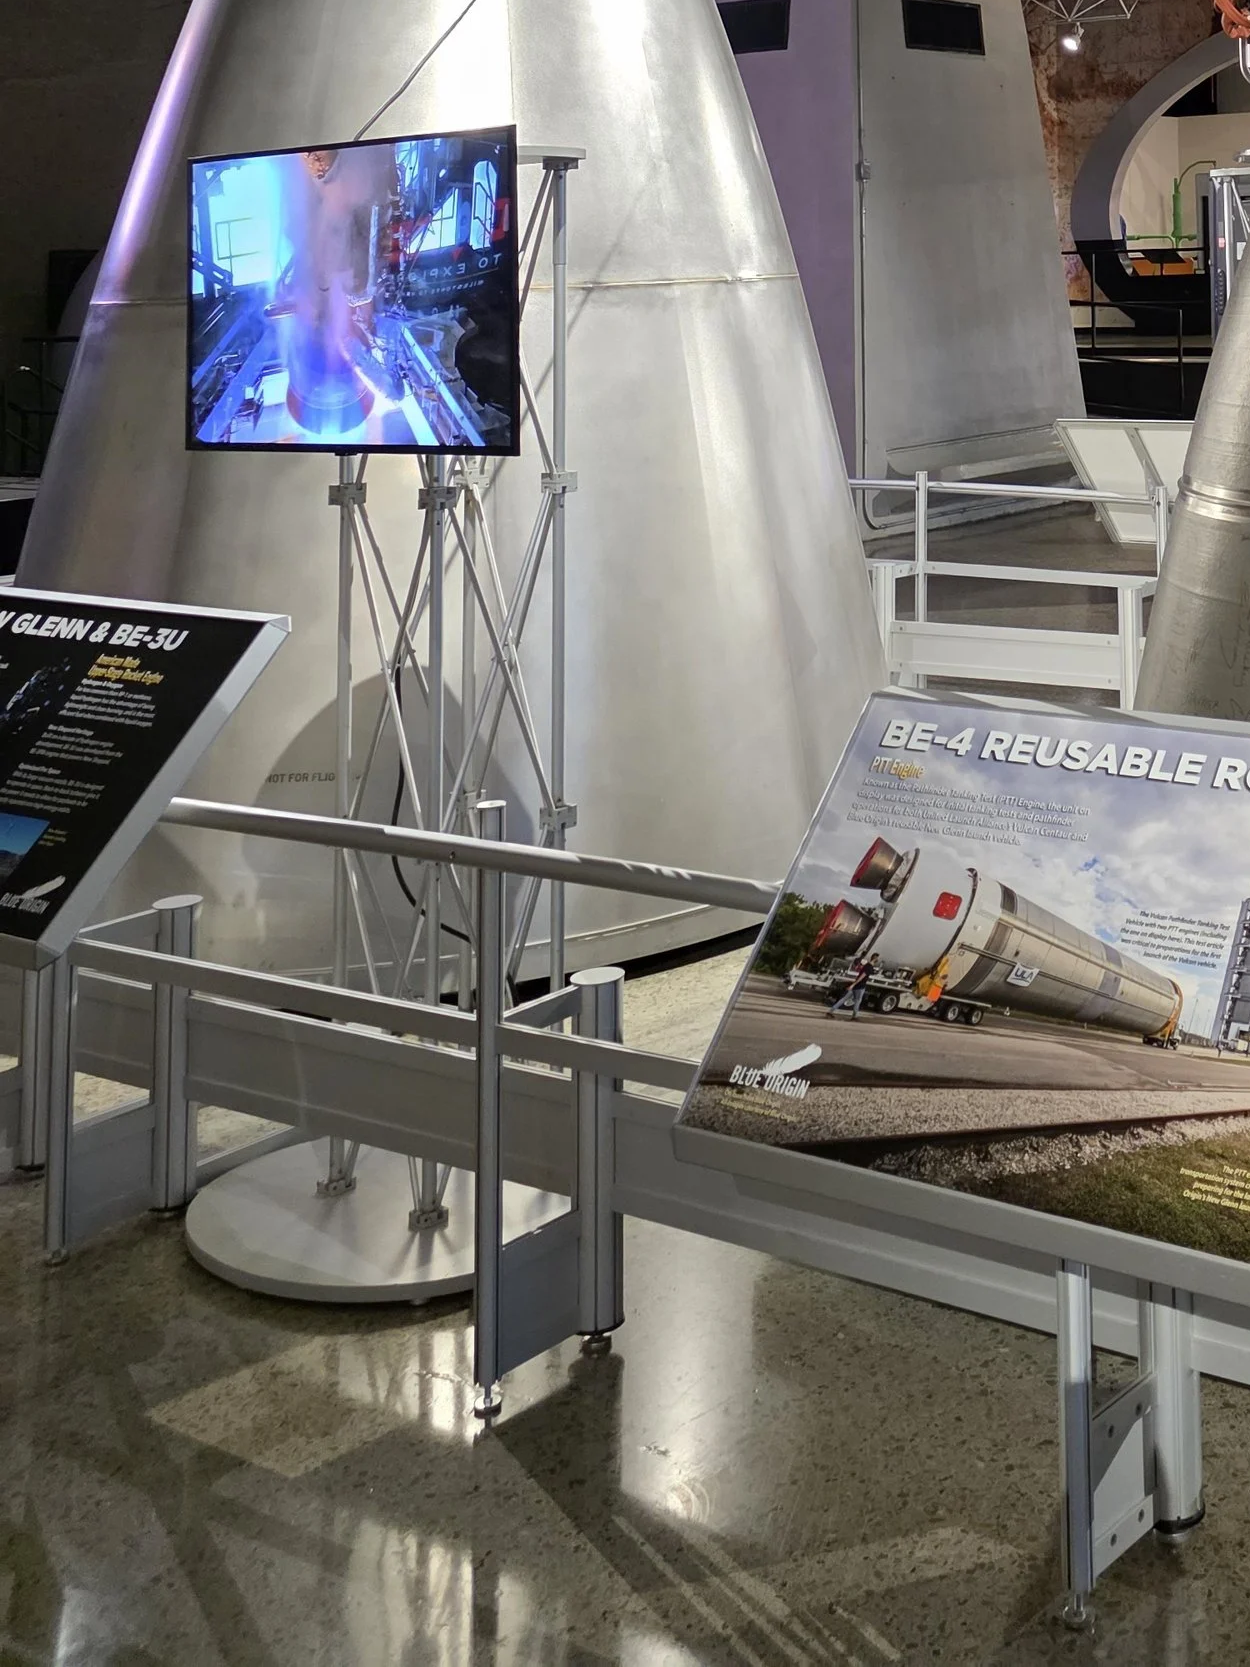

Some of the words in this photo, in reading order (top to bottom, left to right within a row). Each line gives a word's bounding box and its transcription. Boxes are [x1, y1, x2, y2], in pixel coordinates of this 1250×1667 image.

[11, 612, 94, 641] GLENN
[89, 621, 112, 643] &
[108, 623, 189, 651] BE-3U
[880, 719, 976, 757] BE-4
[980, 730, 1207, 785] REUSABLE
[264, 773, 287, 784] NOT
[288, 772, 309, 783] FOR
[311, 772, 336, 783] FLIG
[869, 756, 892, 774] PTT
[890, 758, 926, 780] Engine
[863, 777, 889, 789] Known
[898, 782, 912, 792] the
[912, 783, 948, 797] Pathfinder
[950, 789, 978, 803] Tanking
[980, 793, 995, 804] Test
[1047, 801, 1061, 813] the
[1061, 803, 1080, 815] unit
[1080, 807, 1091, 817] on
[857, 789, 883, 801] display
[884, 793, 900, 803] was
[900, 795, 933, 808] designed
[944, 800, 967, 813] initial
[968, 803, 998, 818] tanking
[999, 807, 1017, 819] tests
[1017, 811, 1032, 822] and
[1032, 813, 1074, 827] pathfinder
[852, 802, 891, 815] operations
[903, 806, 921, 818] both
[921, 809, 948, 822] United
[948, 813, 976, 827] Launch
[1012, 822, 1040, 835] Vulcan
[1040, 826, 1071, 840] Centaur
[1071, 831, 1089, 842] and
[942, 825, 965, 838] Glenn
[965, 828, 992, 842] launch
[1125, 918, 1144, 928] Vehicle
[1144, 921, 1157, 929] with
[1156, 923, 1167, 931] two
[1167, 924, 1179, 932] PTT
[1178, 927, 1199, 937] engines
[1140, 910, 1149, 918] The
[1150, 912, 1168, 922] Vulcan
[1168, 914, 1197, 925] Pathfinder
[1197, 919, 1219, 931] Tanking
[1219, 922, 1230, 931] Test
[1015, 967, 1034, 981] ULA
[729, 1064, 762, 1089] BLUE
[763, 1073, 811, 1099] ORIGIN
[1179, 1167, 1224, 1183] transportation
[1223, 1178, 1245, 1189] system
[1222, 1165, 1234, 1175] The
[1234, 1168, 1247, 1177] PTT
[1192, 1181, 1224, 1196] preparing
[1223, 1186, 1234, 1196] for
[1233, 1189, 1244, 1199] the
[1205, 1194, 1220, 1204] New
[1220, 1198, 1239, 1209] Glenn
